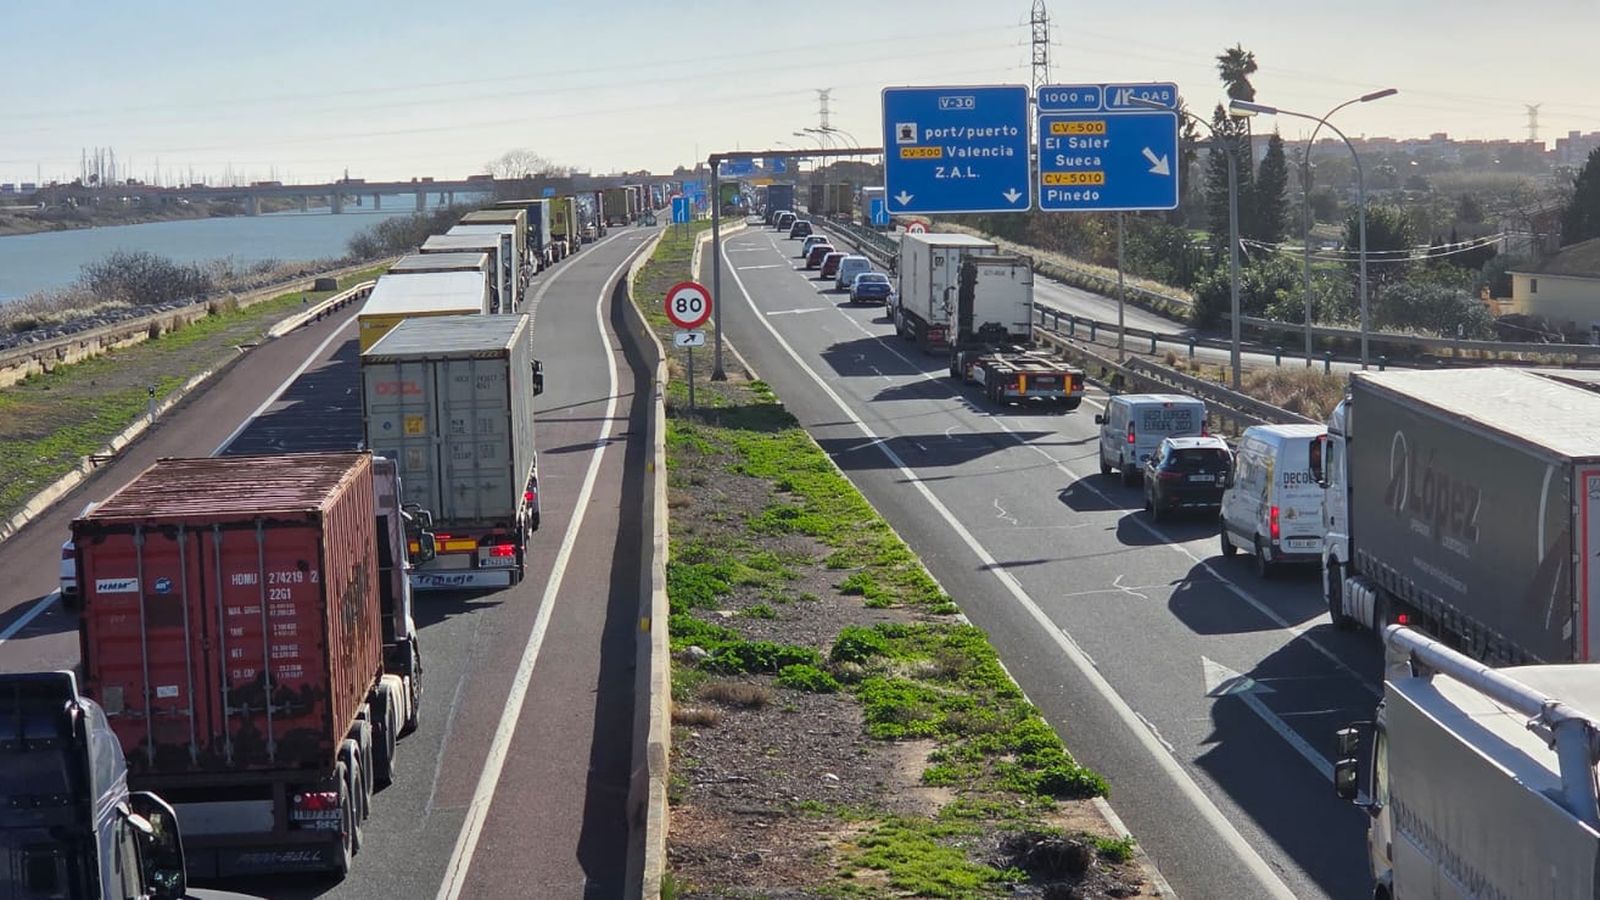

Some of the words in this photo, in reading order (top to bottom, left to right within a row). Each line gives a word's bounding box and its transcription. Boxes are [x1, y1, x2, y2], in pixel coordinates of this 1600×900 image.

[941, 97, 973, 108] V-30
[1045, 92, 1078, 103] 1000
[1084, 94, 1095, 103] m
[925, 125, 1018, 140] port/puerto
[1052, 122, 1104, 133] CV-500
[1045, 138, 1060, 149] El
[1068, 137, 1110, 149] Saler
[901, 147, 942, 158] CV-500
[946, 145, 1014, 158] Valencia
[1055, 154, 1101, 166] Sueca
[935, 166, 980, 178] Z.A.L.
[1044, 173, 1102, 184] CV-5010
[1047, 189, 1100, 201] Pinedo
[676, 298, 702, 313] 80
[232, 574, 258, 585] HDMU
[268, 571, 303, 584] 274219
[310, 571, 319, 583] 2
[269, 588, 291, 600] 22G1
